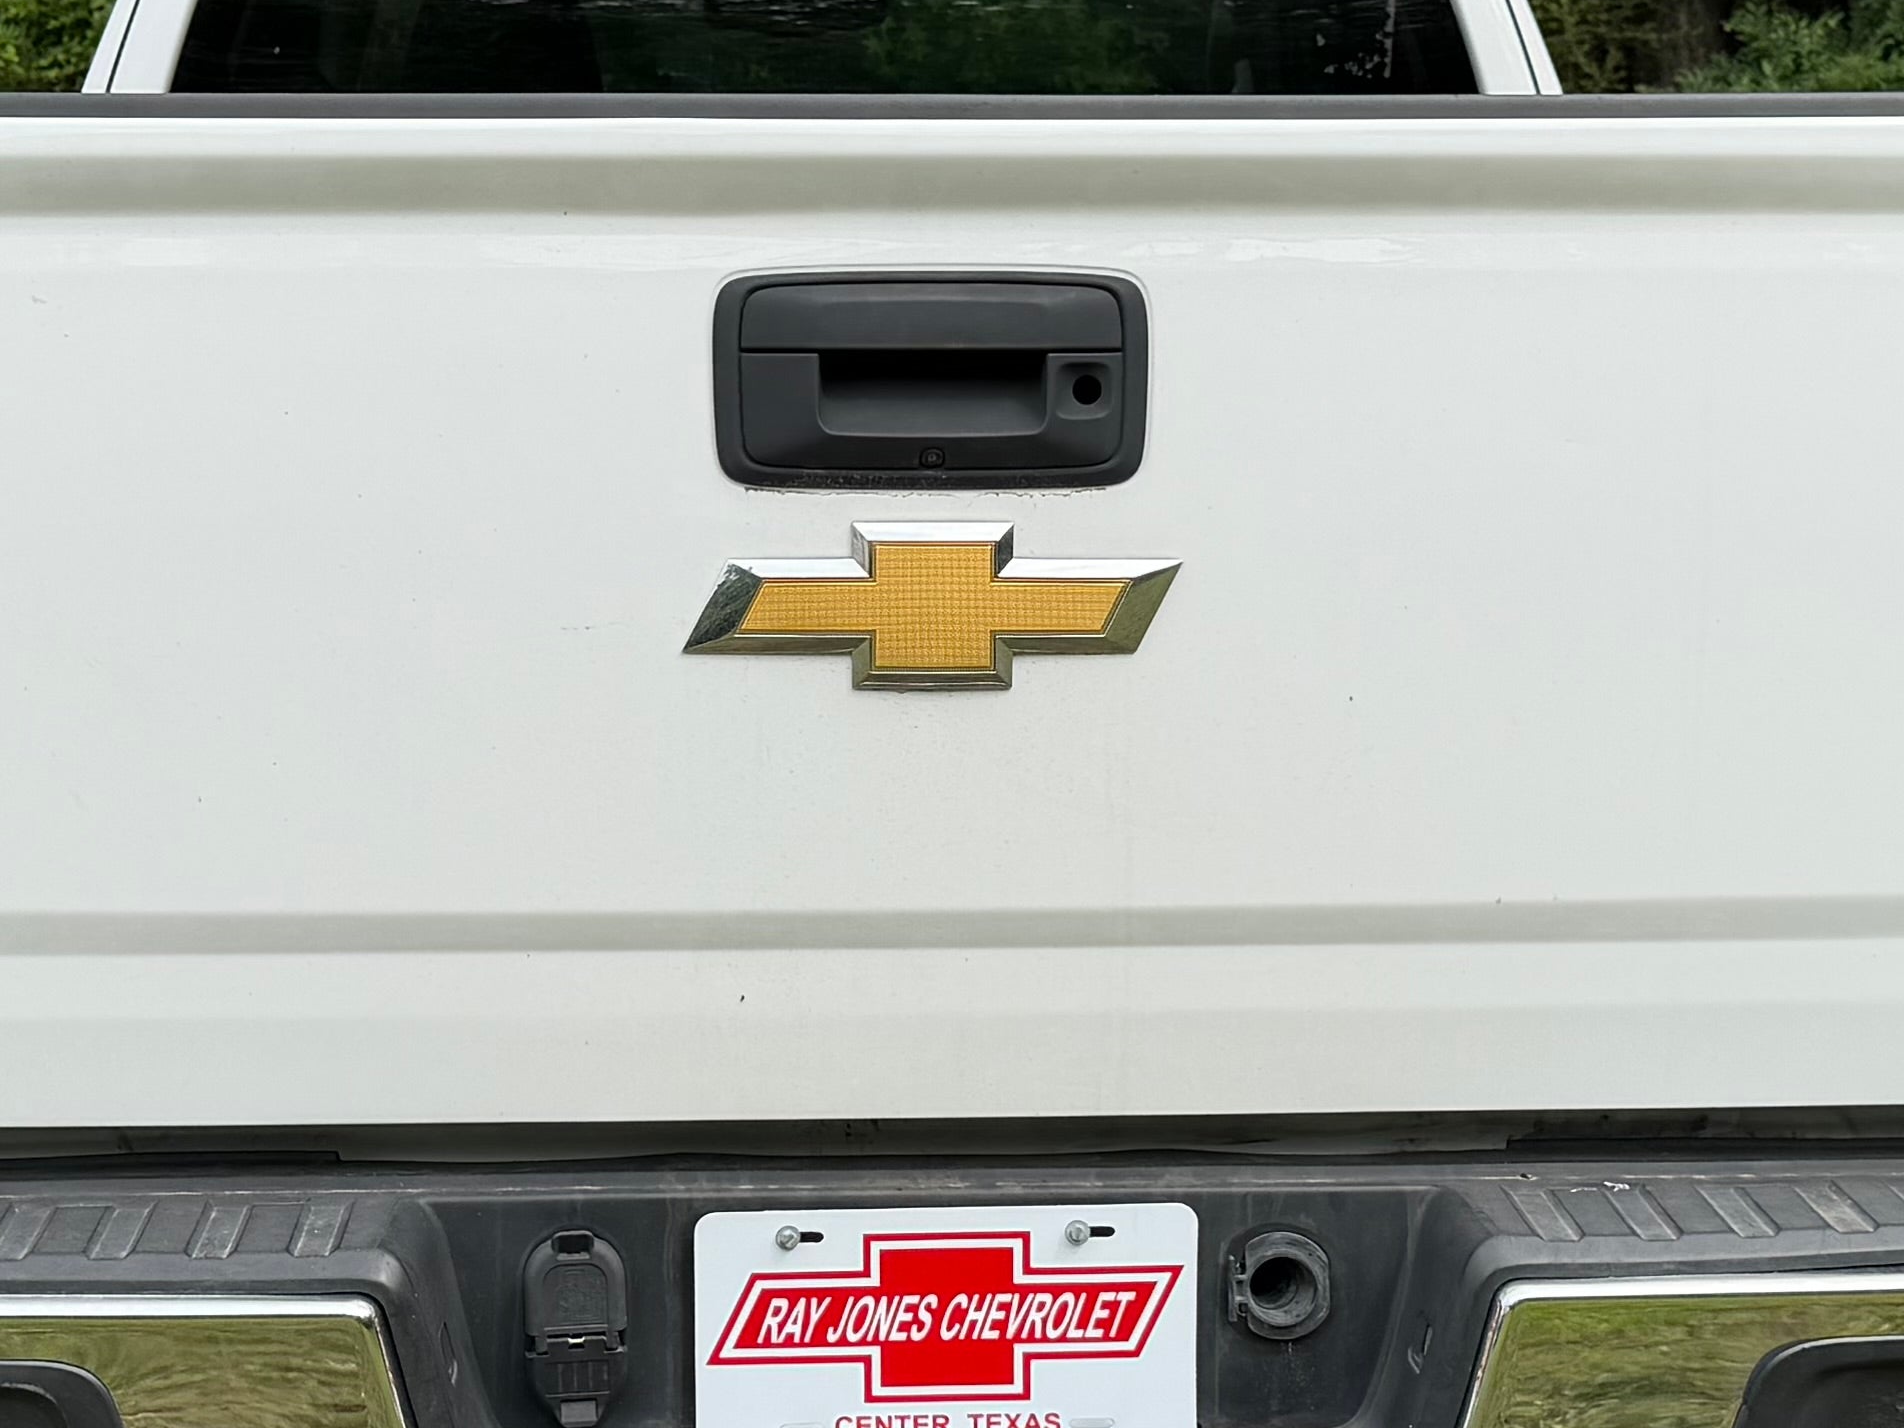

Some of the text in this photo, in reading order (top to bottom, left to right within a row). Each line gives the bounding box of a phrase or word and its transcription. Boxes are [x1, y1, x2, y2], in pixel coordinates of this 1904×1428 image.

[756, 1291, 1137, 1344] RAY JONES CHEVROLET
